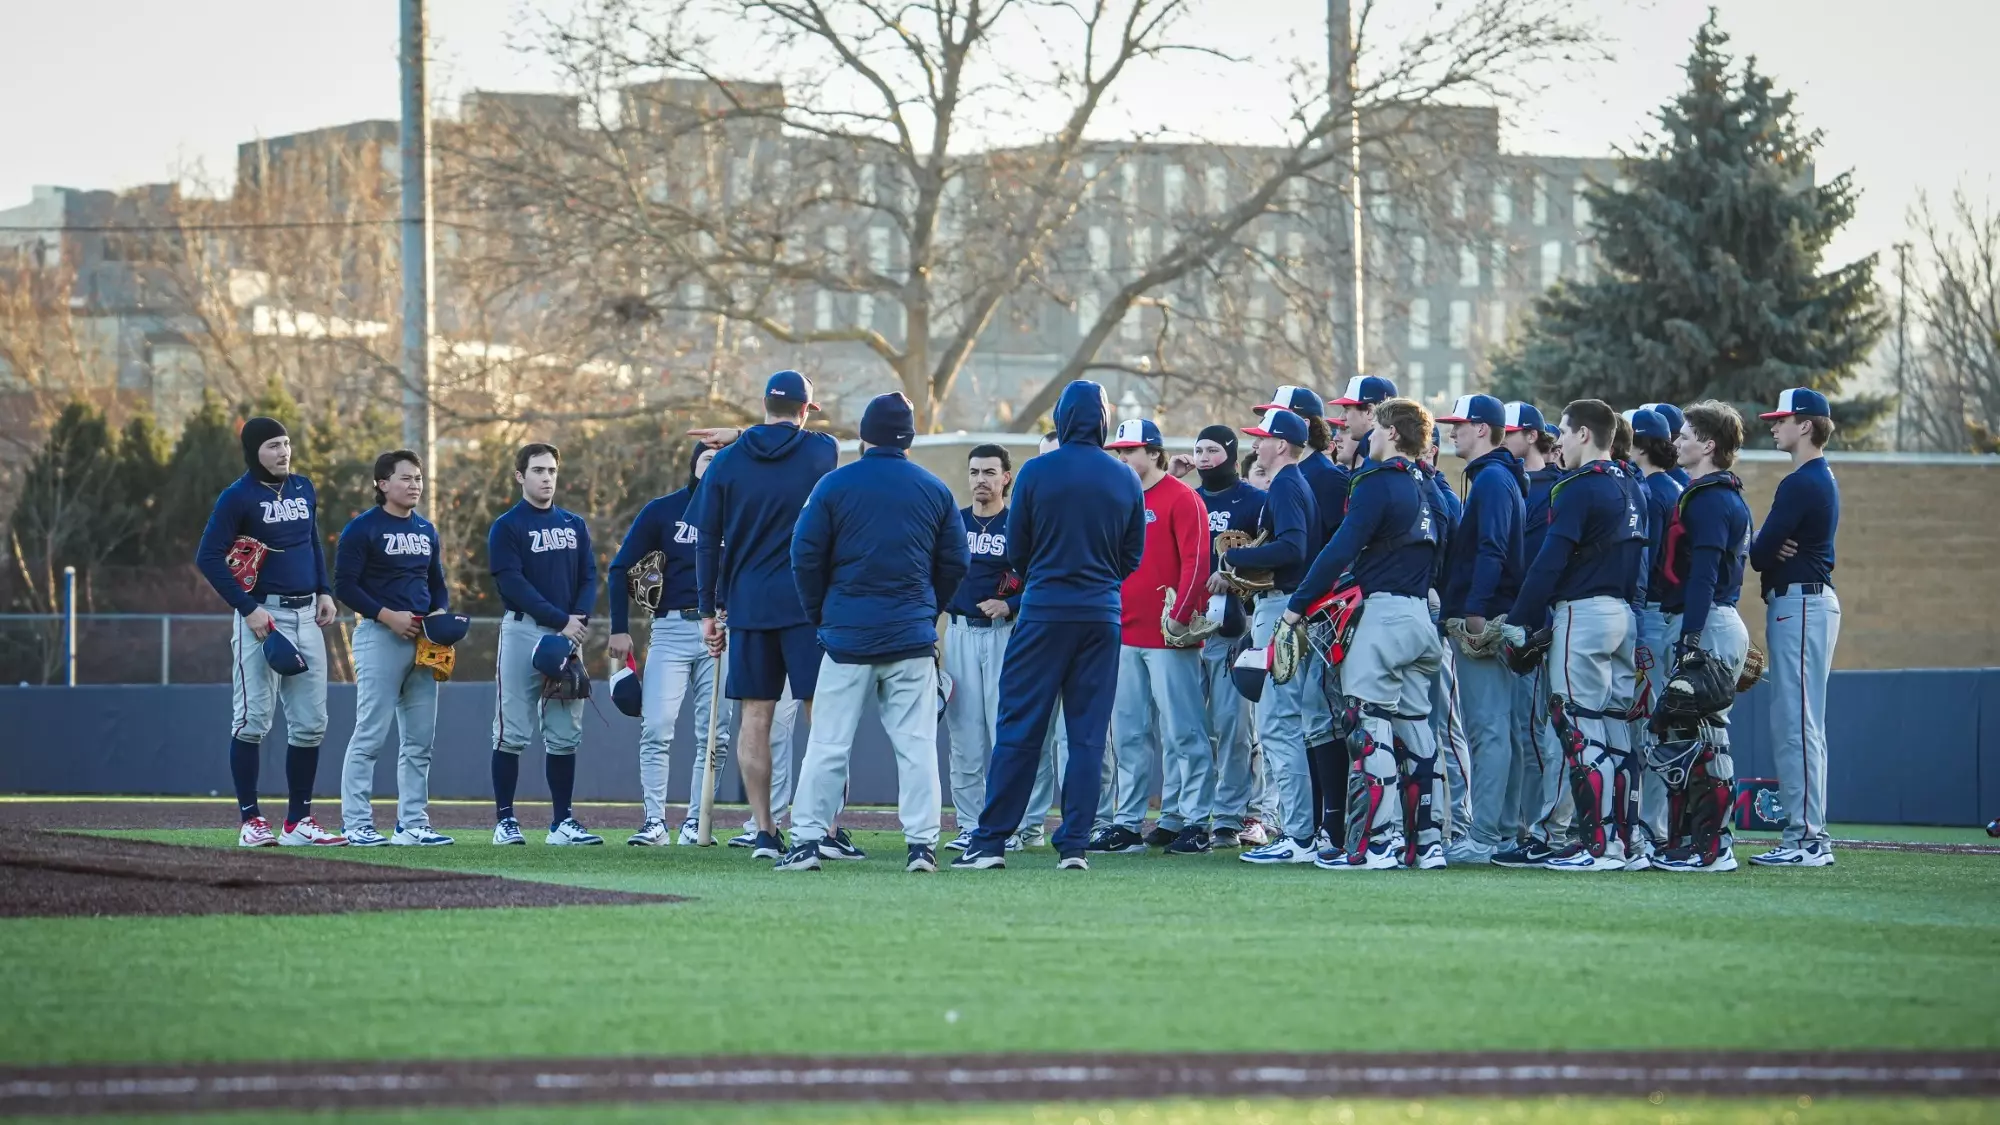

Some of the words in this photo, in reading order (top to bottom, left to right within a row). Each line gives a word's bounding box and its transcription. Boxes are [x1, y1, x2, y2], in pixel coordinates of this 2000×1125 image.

[260, 498, 310, 524] ZAGS
[383, 533, 431, 556] ZAGS
[529, 528, 577, 553] ZAGS
